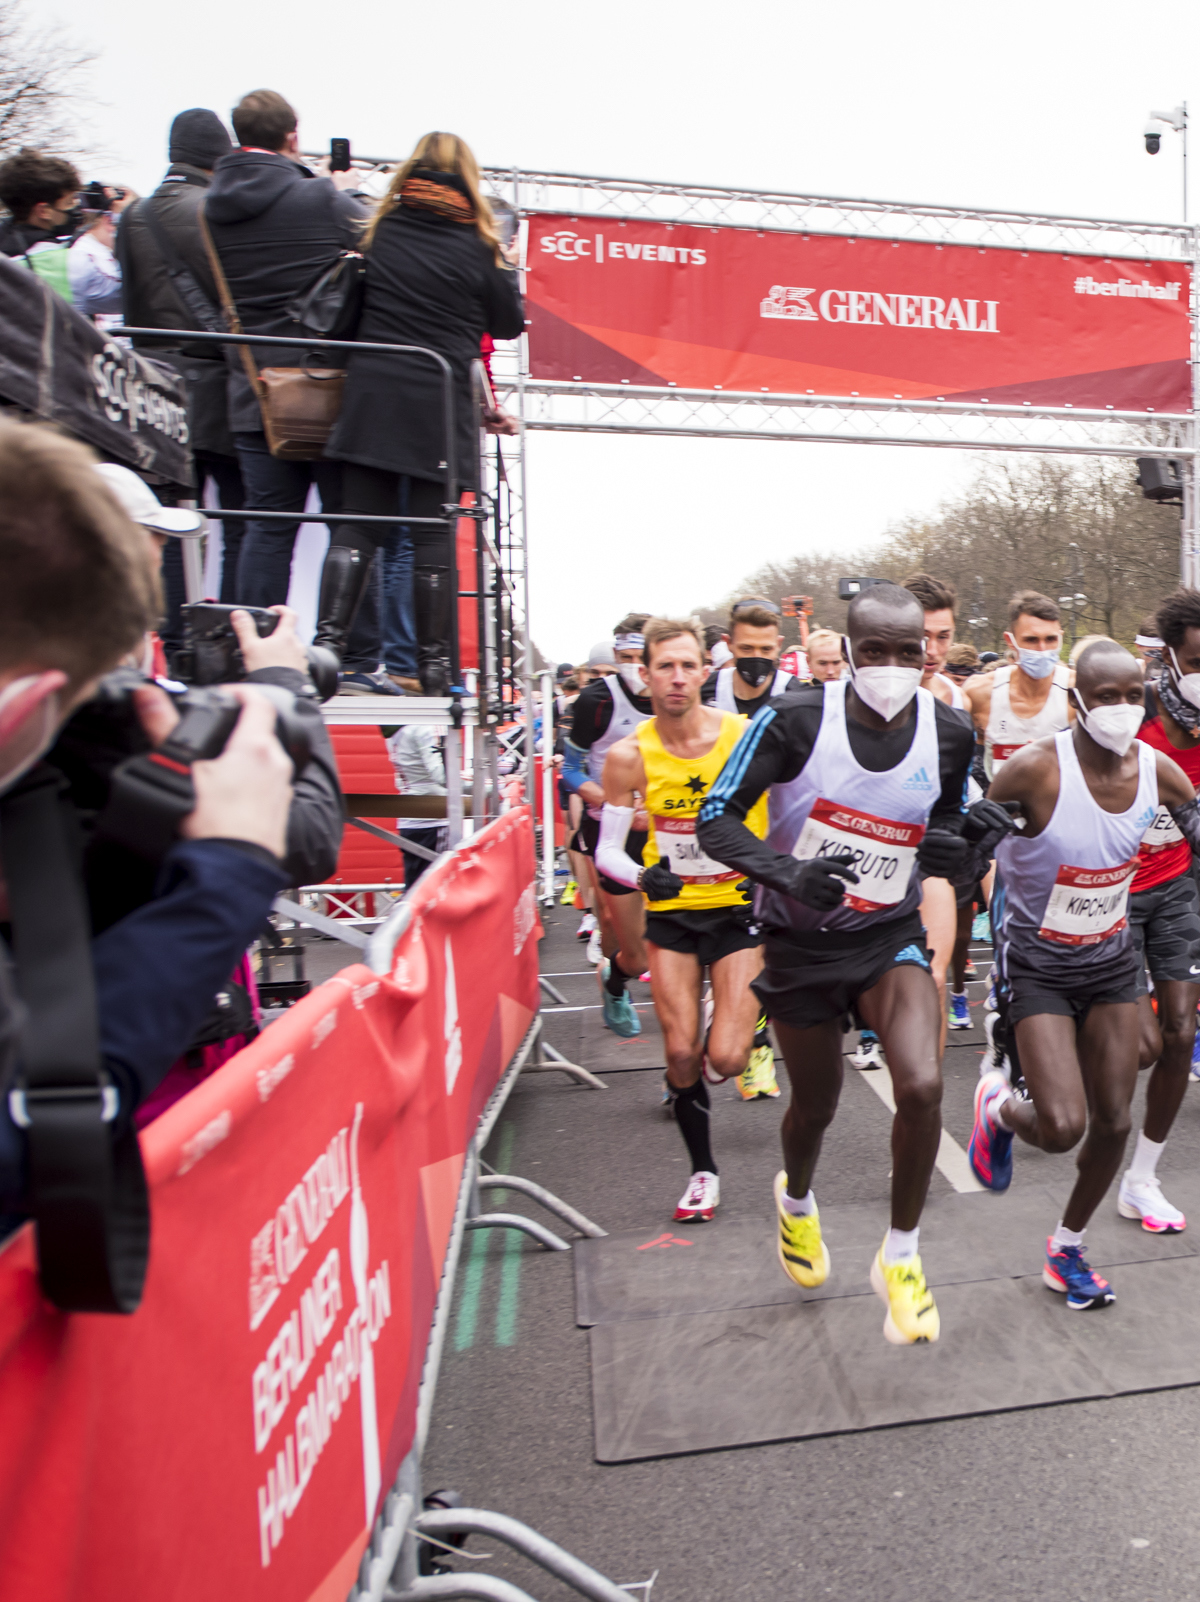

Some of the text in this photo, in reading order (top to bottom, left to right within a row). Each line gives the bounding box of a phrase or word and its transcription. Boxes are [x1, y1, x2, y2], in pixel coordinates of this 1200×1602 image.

[540, 231, 707, 265] SCC EVENTS
[1073, 276, 1182, 301] #berlinhalf
[819, 289, 1000, 333] GENERALI
[850, 817, 912, 842] GENERALI
[252, 1248, 343, 1454] BERLINER
